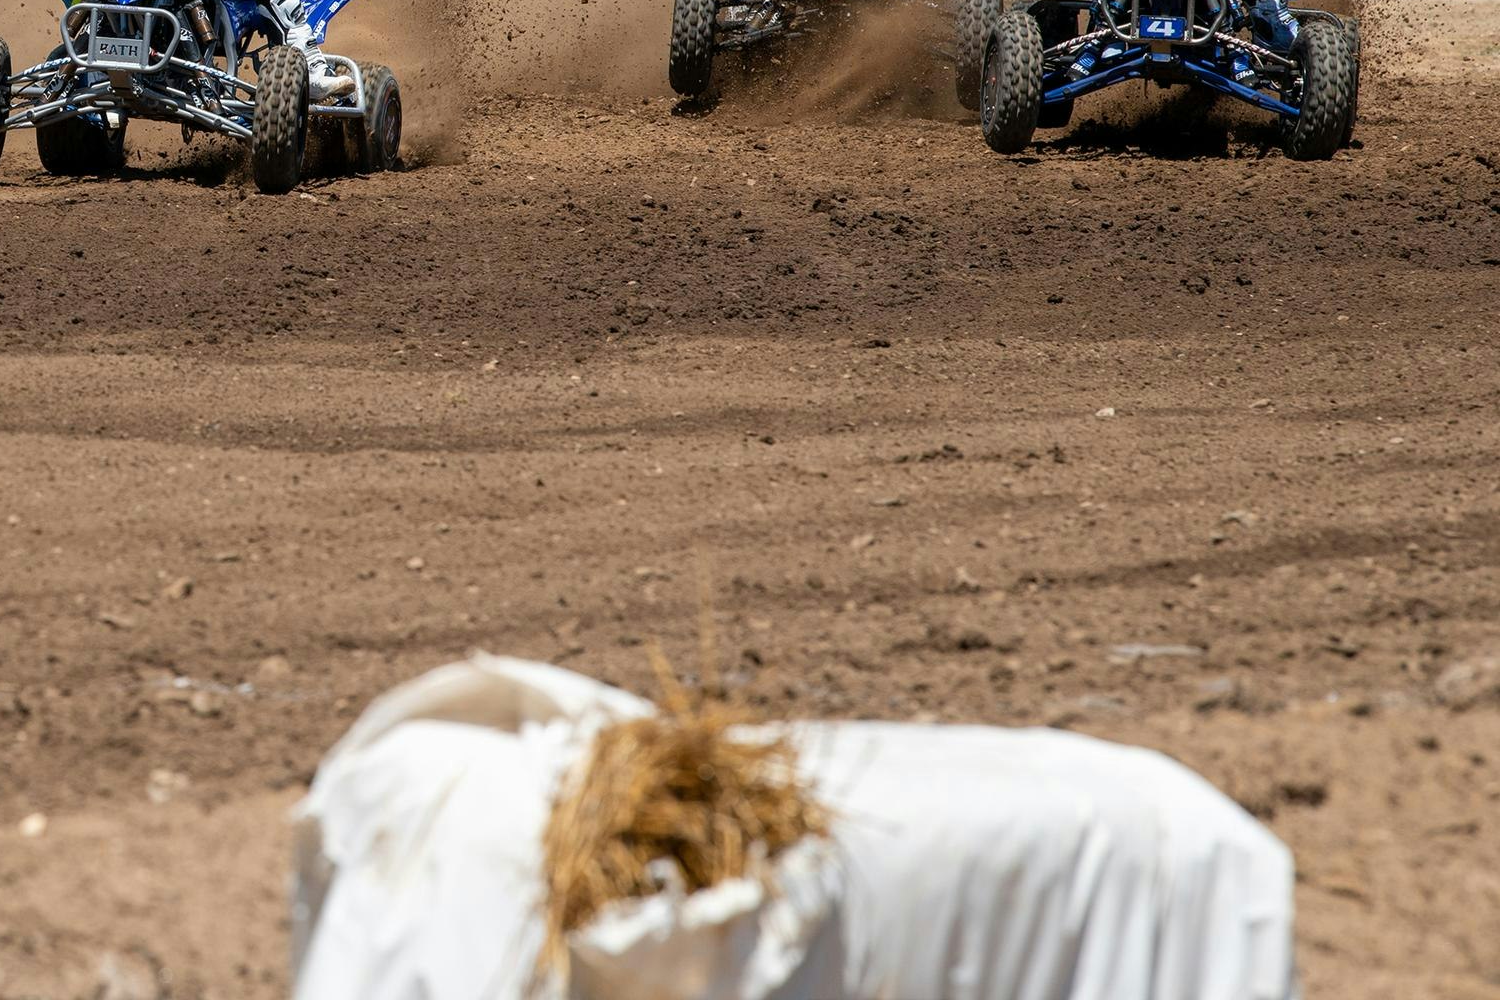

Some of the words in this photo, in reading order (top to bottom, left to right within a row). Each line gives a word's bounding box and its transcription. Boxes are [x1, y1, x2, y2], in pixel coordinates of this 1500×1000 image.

[1147, 21, 1176, 37] 4
[100, 43, 139, 57] RATH
[1070, 63, 1090, 76] Elka
[1235, 69, 1255, 81] Elka
